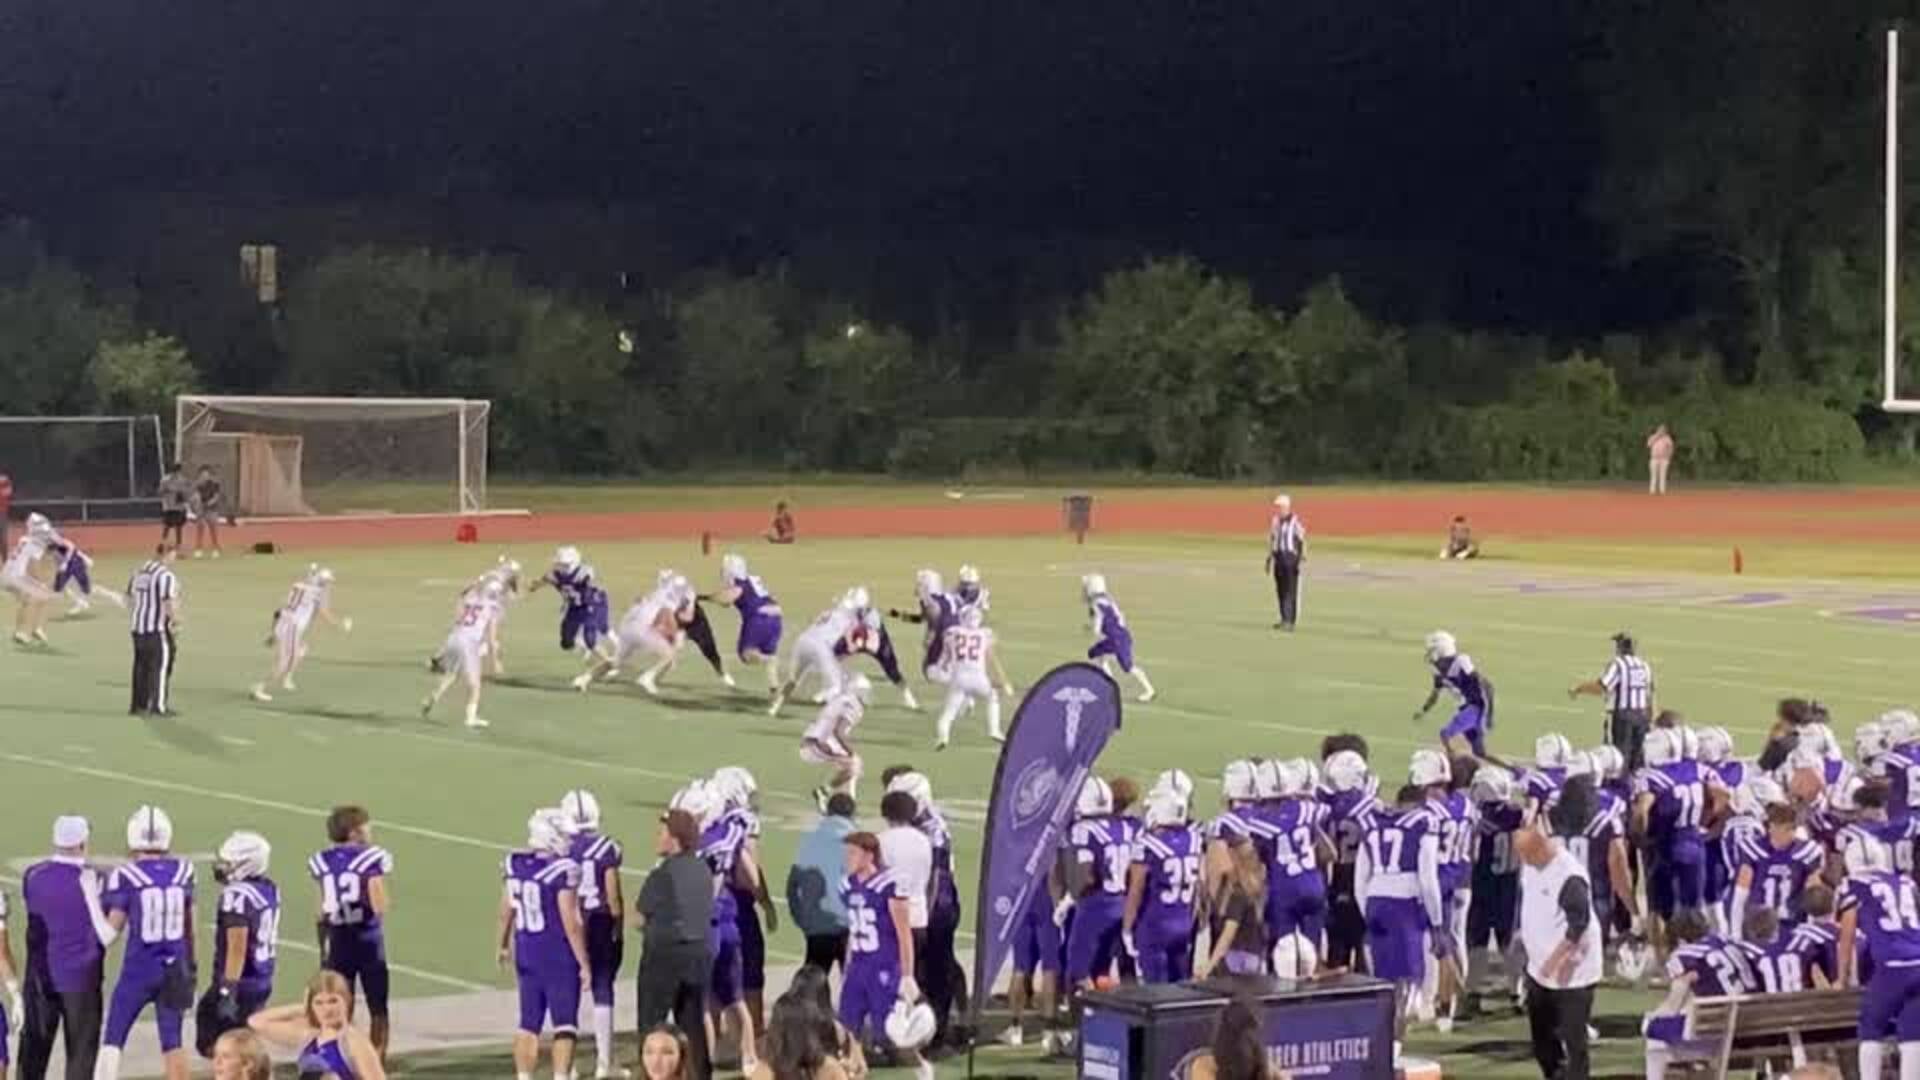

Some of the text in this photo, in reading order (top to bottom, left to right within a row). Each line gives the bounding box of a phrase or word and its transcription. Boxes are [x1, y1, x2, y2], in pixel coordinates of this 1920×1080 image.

[955, 634, 981, 660] 22
[1272, 826, 1313, 876] 43
[1366, 829, 1403, 874] 17
[1160, 856, 1198, 904] 35
[1871, 877, 1920, 932] 34
[1303, 1037, 1369, 1065] ATHLETICS
